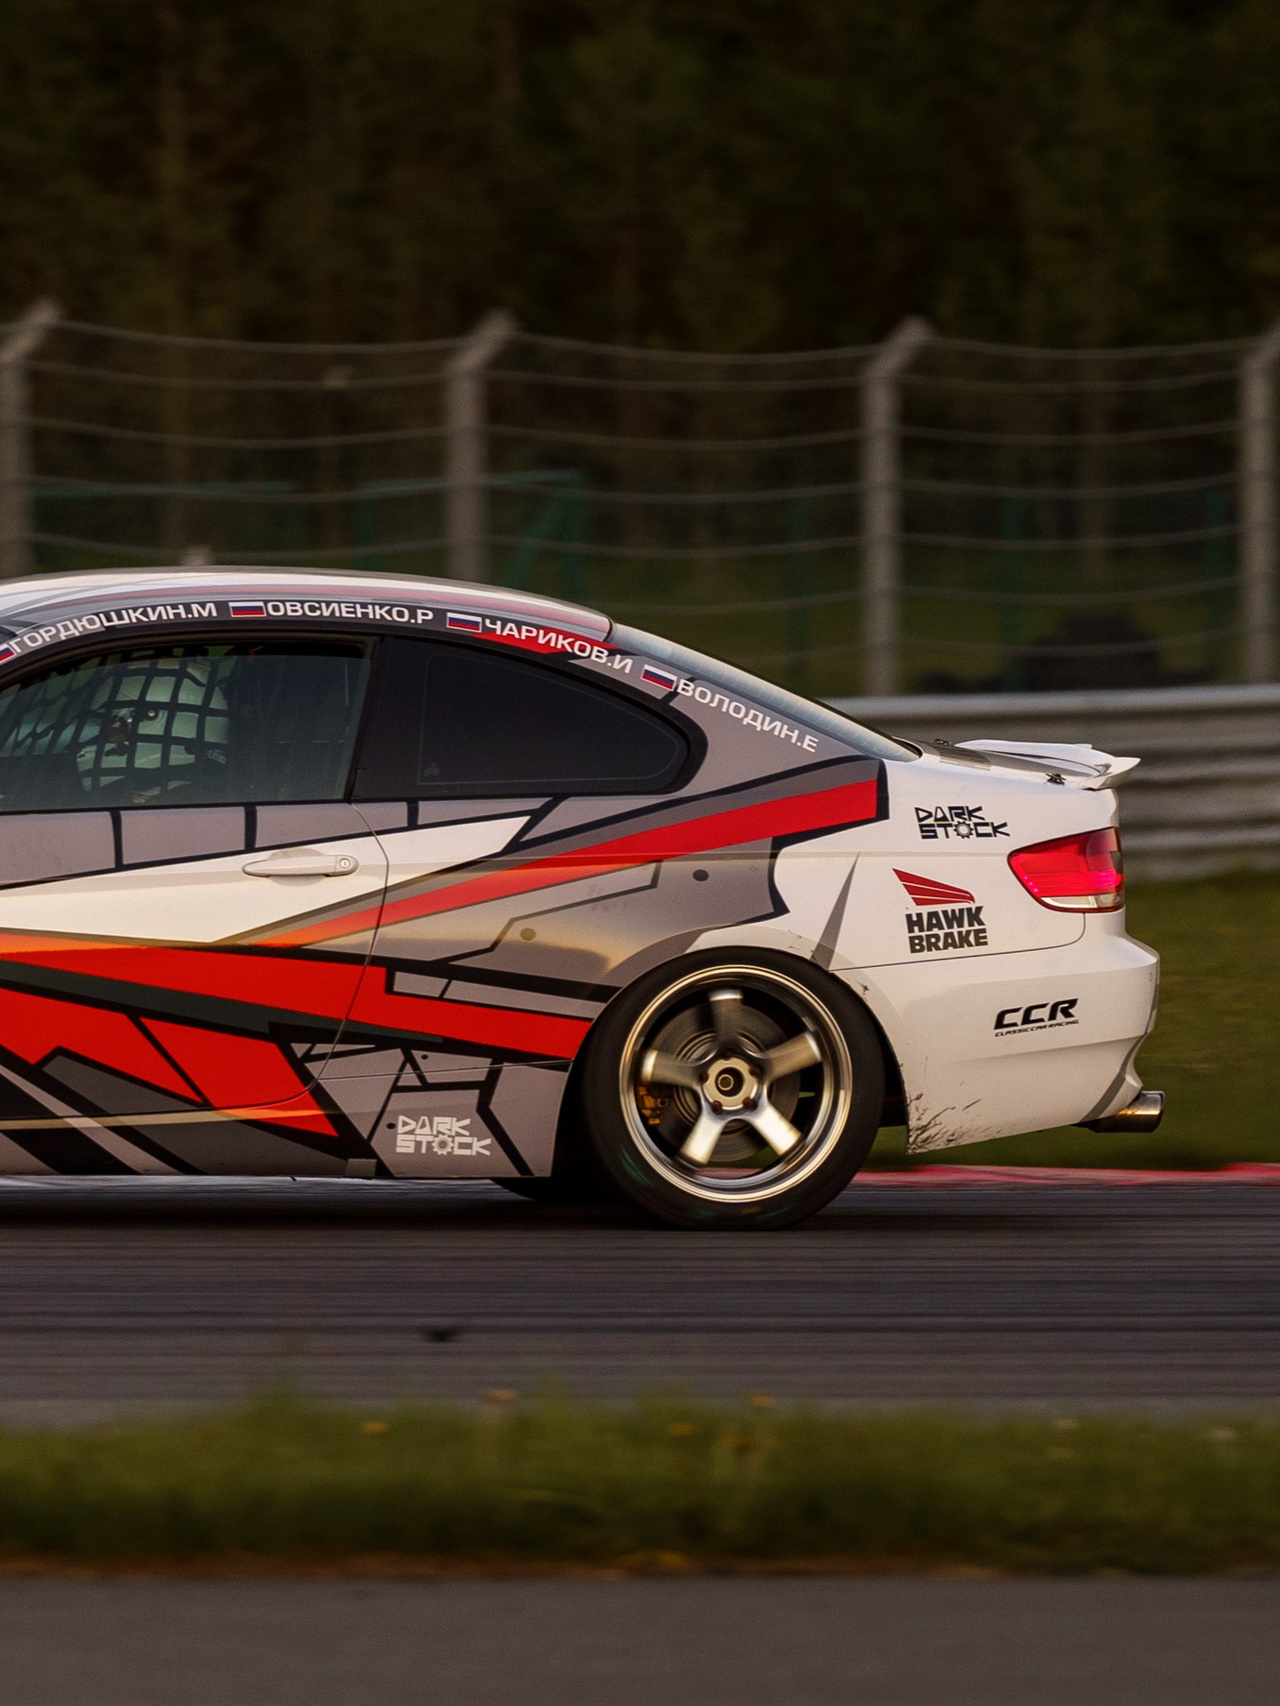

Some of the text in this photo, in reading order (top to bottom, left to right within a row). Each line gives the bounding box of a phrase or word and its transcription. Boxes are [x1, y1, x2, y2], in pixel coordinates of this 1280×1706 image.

[267, 601, 434, 624] ОВСИЕНКО.Р
[11, 602, 217, 654] ГОРДЮШКИН.М
[485, 618, 633, 674] ЧАРИКОВ.И
[677, 679, 819, 753] ВОЛОДИН.Е
[914, 806, 986, 823] DARK
[918, 821, 1011, 840] STOCK
[905, 906, 986, 934] HAWK
[908, 928, 989, 954] BRAKE
[994, 998, 1079, 1030] CCR
[397, 1115, 471, 1136] DARK
[396, 1134, 492, 1156] STOCK
